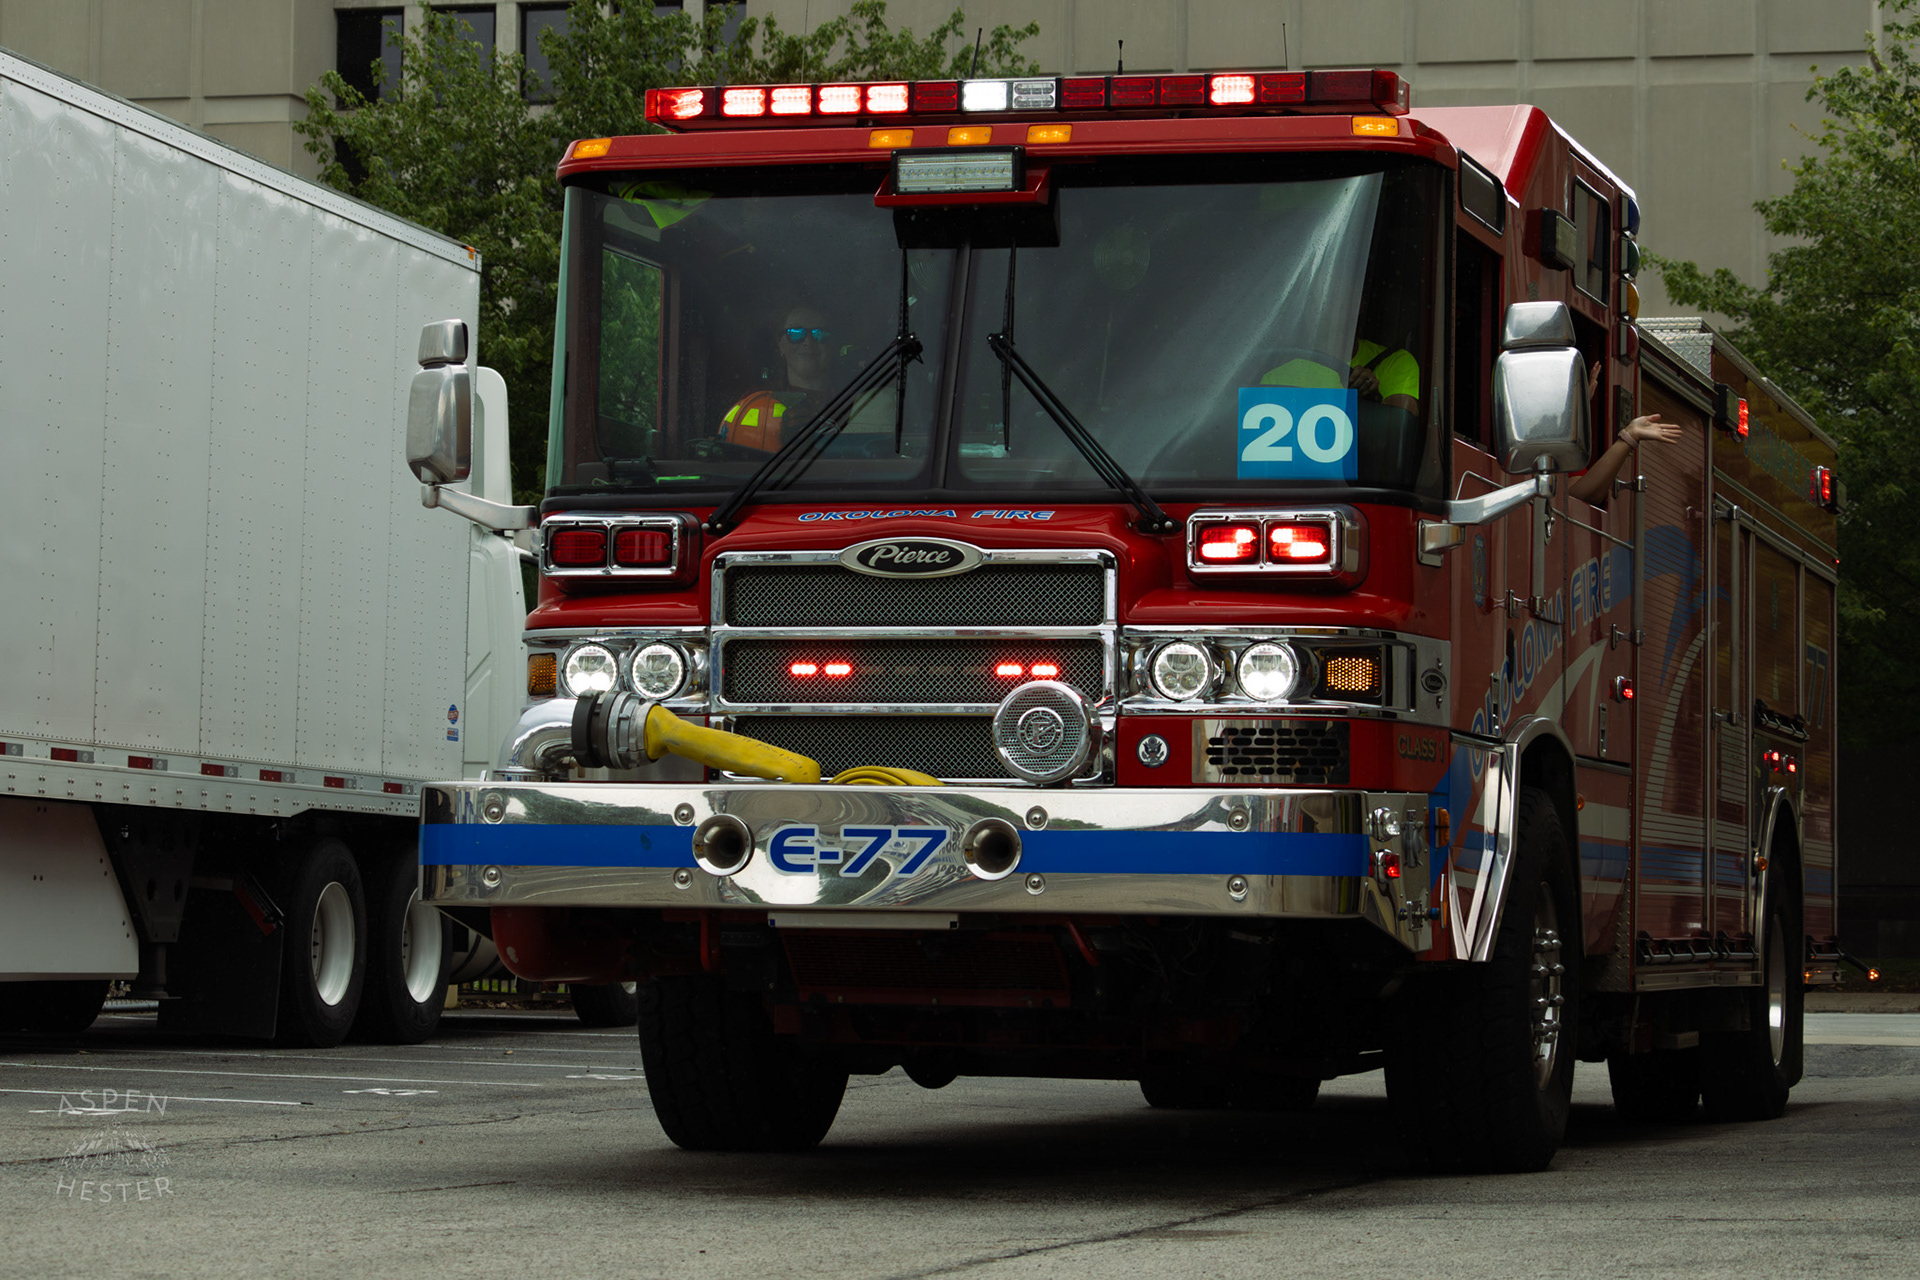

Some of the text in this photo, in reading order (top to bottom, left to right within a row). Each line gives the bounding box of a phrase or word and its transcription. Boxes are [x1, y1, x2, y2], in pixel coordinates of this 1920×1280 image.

[1241, 403, 1353, 463] 20
[798, 509, 1056, 522] OKOLONA FIRE
[868, 545, 951, 567] Pierce
[1570, 551, 1612, 637] FIRE
[1805, 640, 1828, 729] 77
[1397, 734, 1445, 763] CLASS 1
[766, 823, 951, 877] E-77
